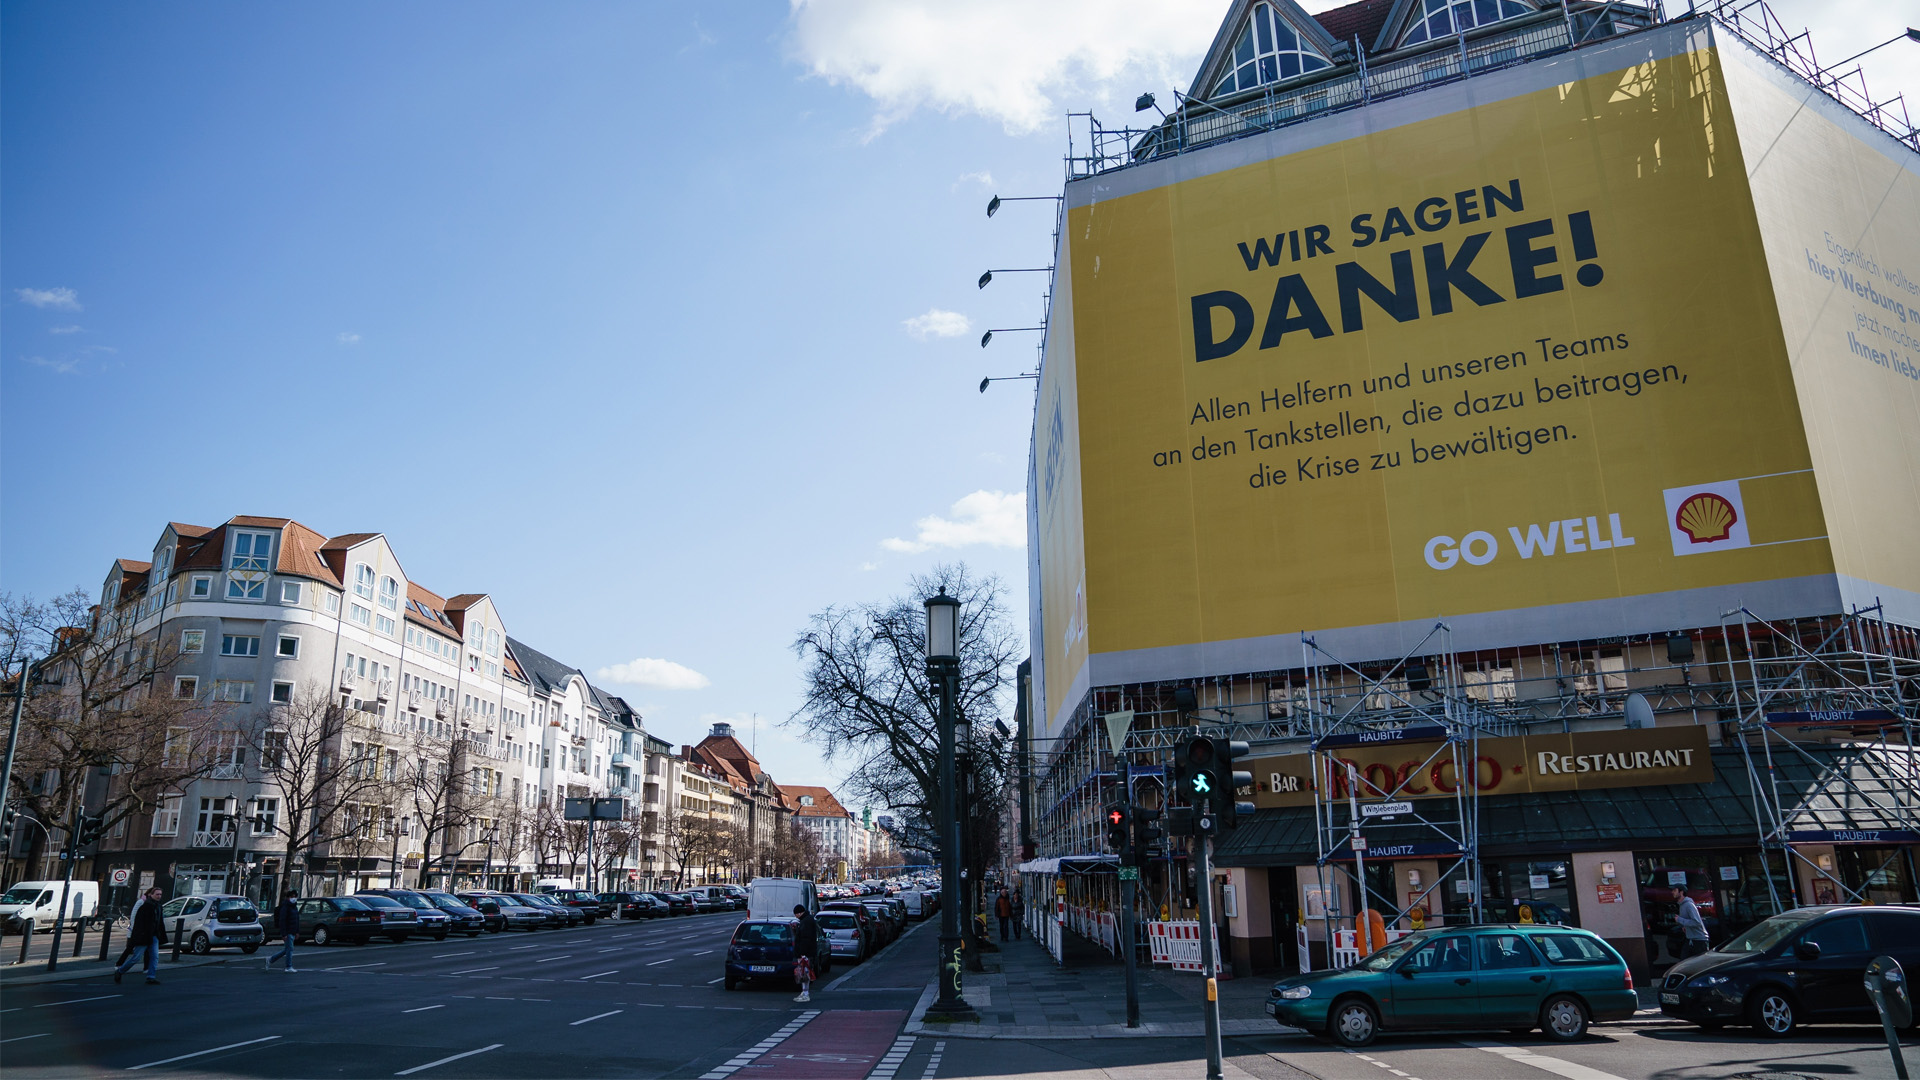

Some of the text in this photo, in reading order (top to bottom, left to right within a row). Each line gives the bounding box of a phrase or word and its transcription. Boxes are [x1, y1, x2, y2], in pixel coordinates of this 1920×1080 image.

[1237, 179, 1525, 271] WIR SAGEN
[1823, 231, 1880, 277] Eigentlich
[1190, 210, 1605, 362] DANKE!
[1805, 248, 1835, 283] hier
[1838, 267, 1906, 323] Werbung
[1852, 305, 1881, 335] jetzt
[1190, 332, 1629, 425] Allen Helfern und unseren Teams
[1847, 331, 1920, 380] Ihnen lieb
[1153, 364, 1688, 468] an den Tankstellen, die dazu beitragen,
[1249, 424, 1577, 489] die Krise zu bewältigen.
[1423, 512, 1635, 570] GO WELL
[1359, 730, 1403, 743] HAUBITZ
[1809, 711, 1855, 721] HAUBITZ
[1270, 772, 1298, 793] BAR
[1326, 756, 1502, 799] ROCCO
[1537, 749, 1694, 775] RESTAURANT
[1369, 845, 1414, 857] HAUBITZ
[1834, 831, 1880, 841] HAUBITZ
